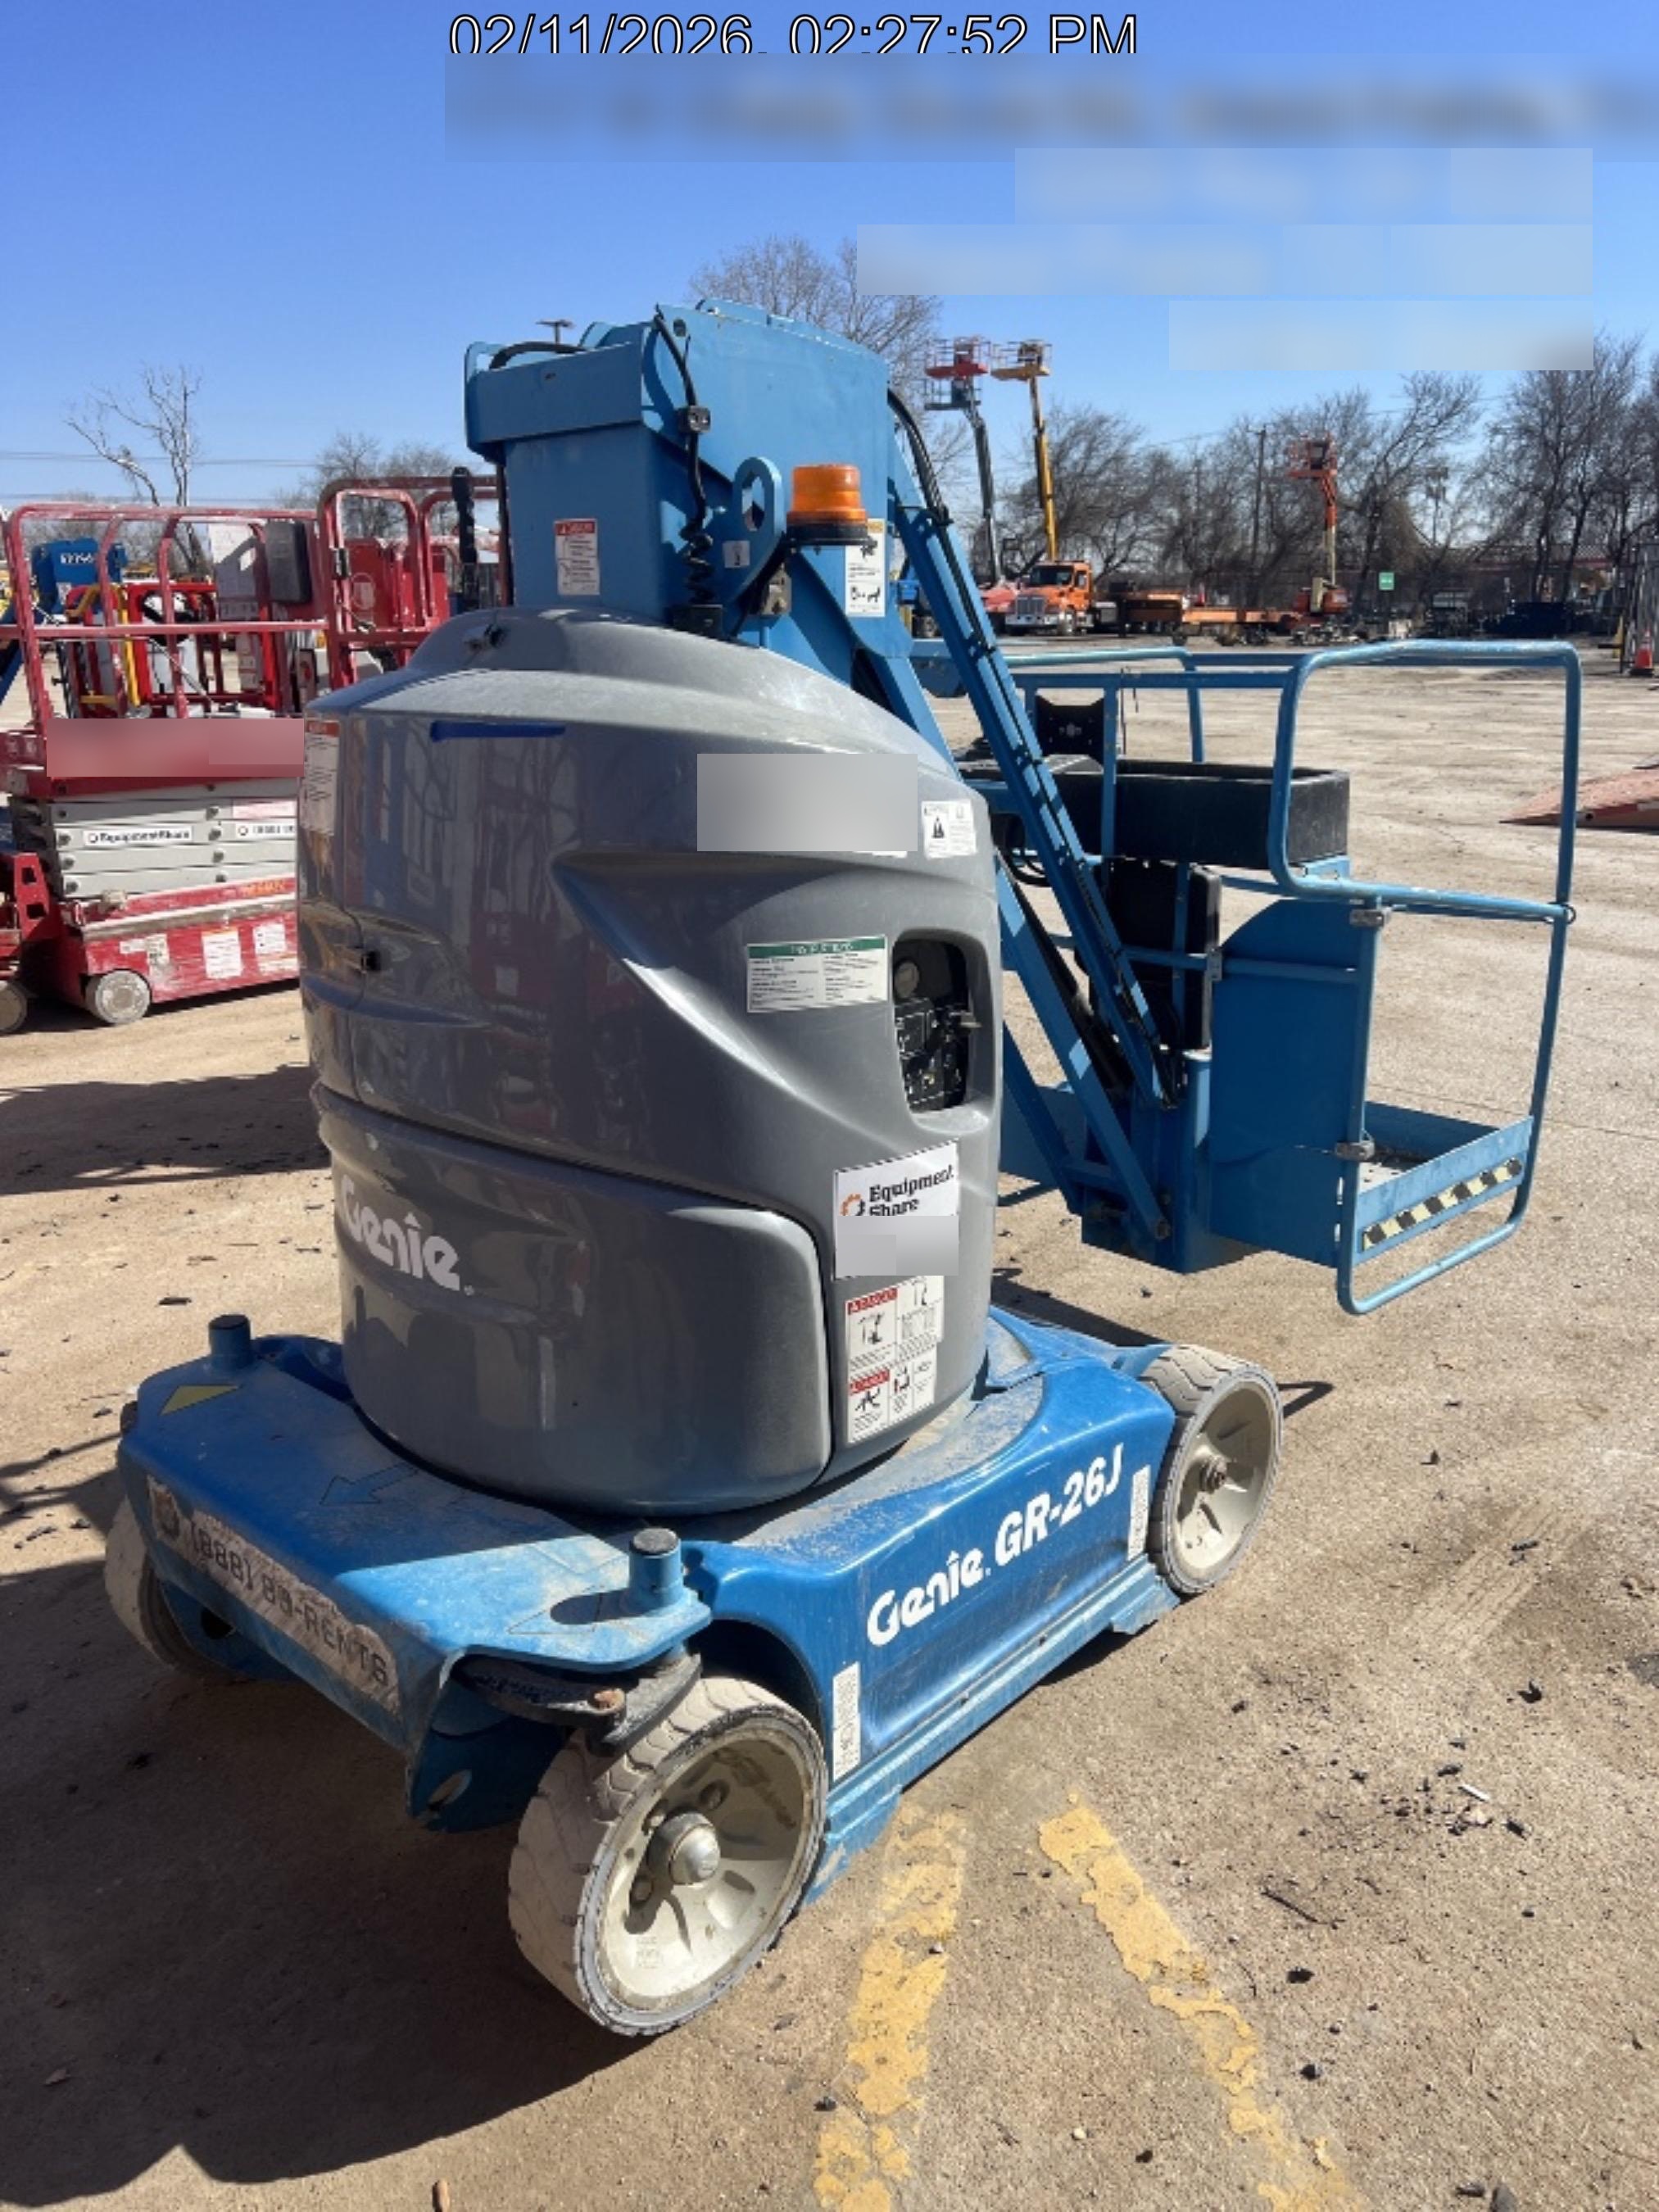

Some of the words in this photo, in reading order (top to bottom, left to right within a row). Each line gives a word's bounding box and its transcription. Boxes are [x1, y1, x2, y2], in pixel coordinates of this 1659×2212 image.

[341, 1174, 461, 1292] Genie
[868, 1164, 954, 1203] Equipment
[867, 1548, 984, 1648] Genie
[995, 1443, 1124, 1566] GR-26J
